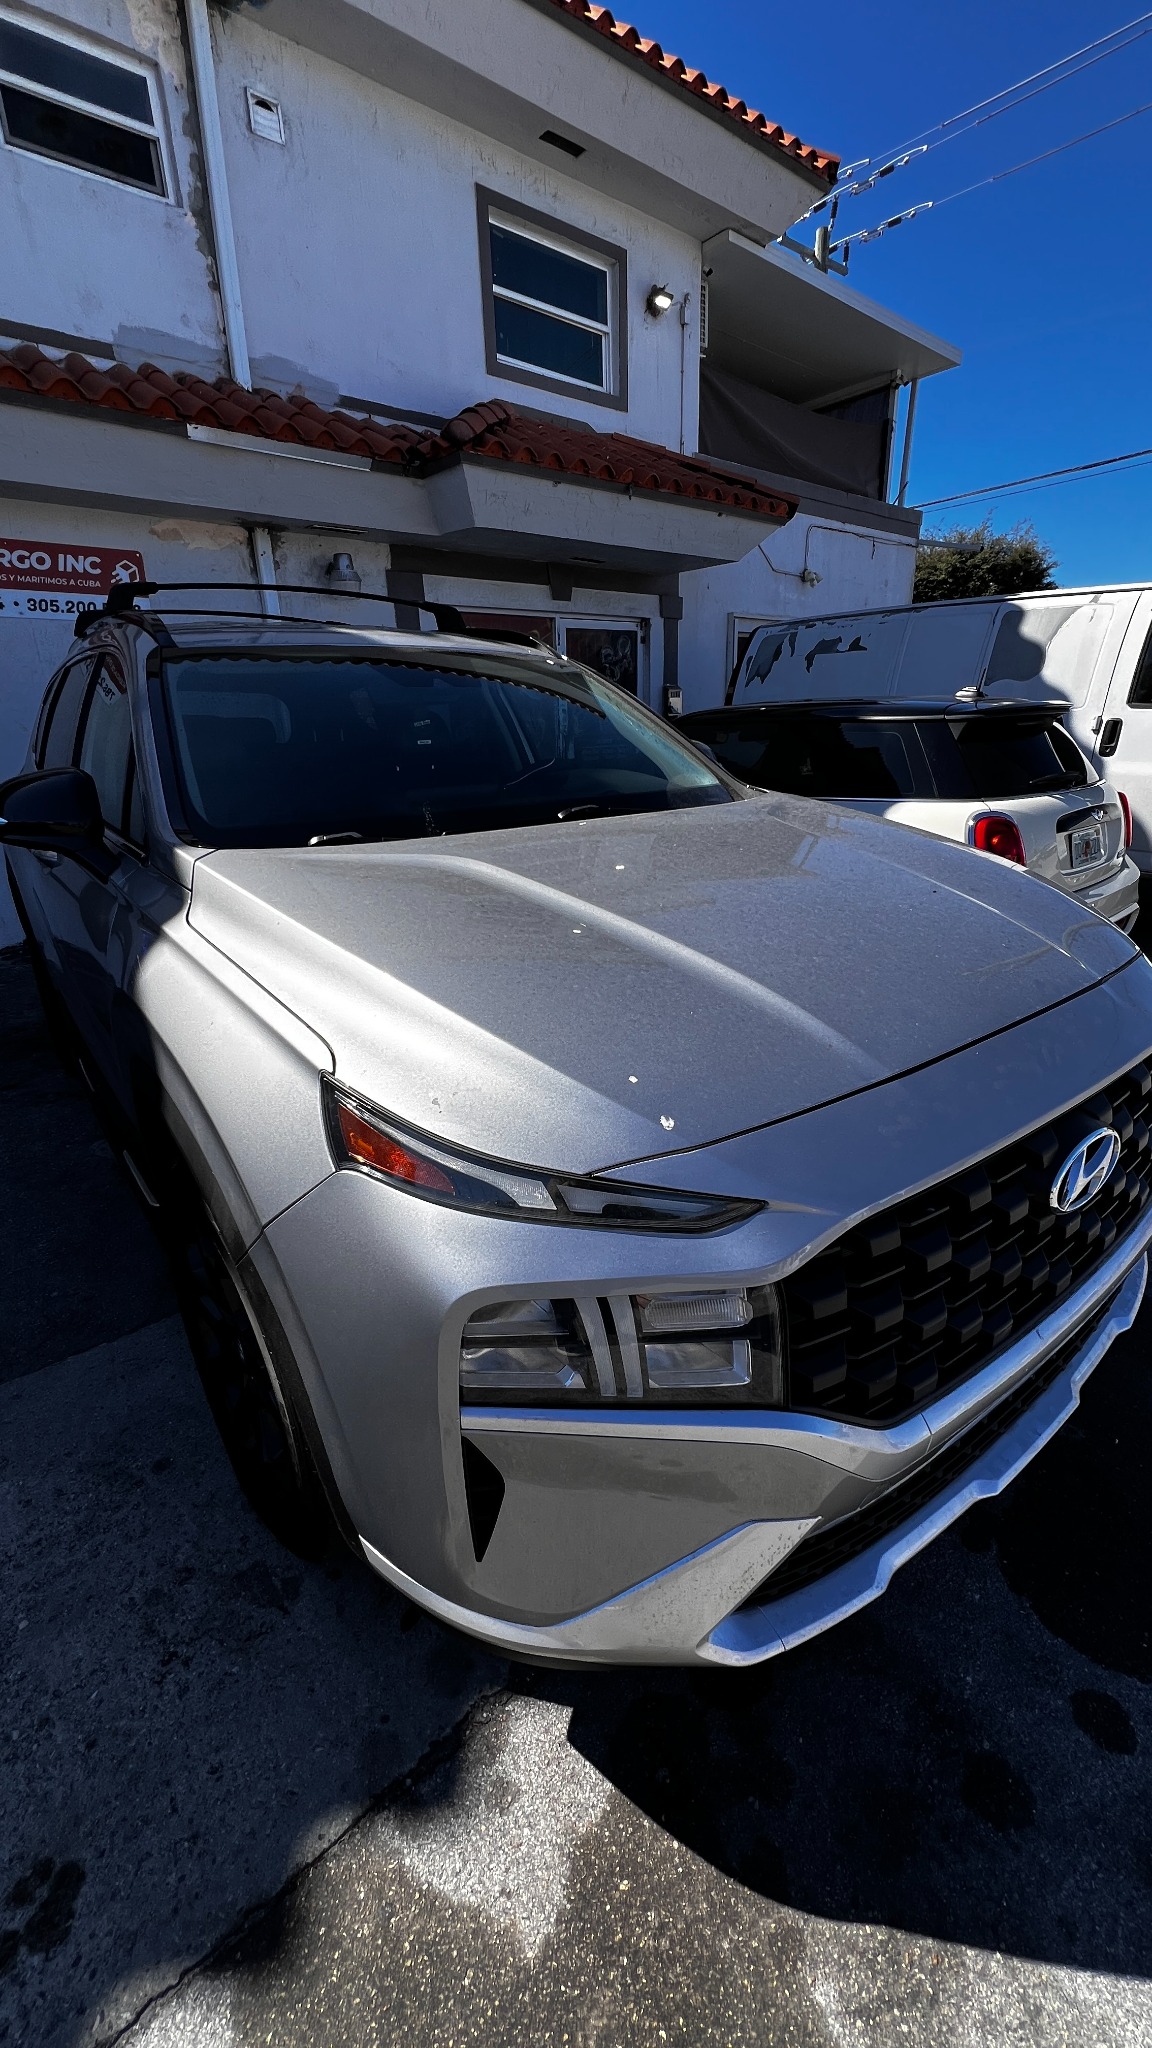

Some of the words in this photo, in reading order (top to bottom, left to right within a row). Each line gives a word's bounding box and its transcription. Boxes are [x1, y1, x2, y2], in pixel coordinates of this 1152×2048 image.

[58, 553, 102, 575] INC
[9, 574, 16, 582] Y
[17, 575, 68, 586] MARITIMOS
[69, 577, 76, 586] A
[77, 579, 101, 588] CUBA
